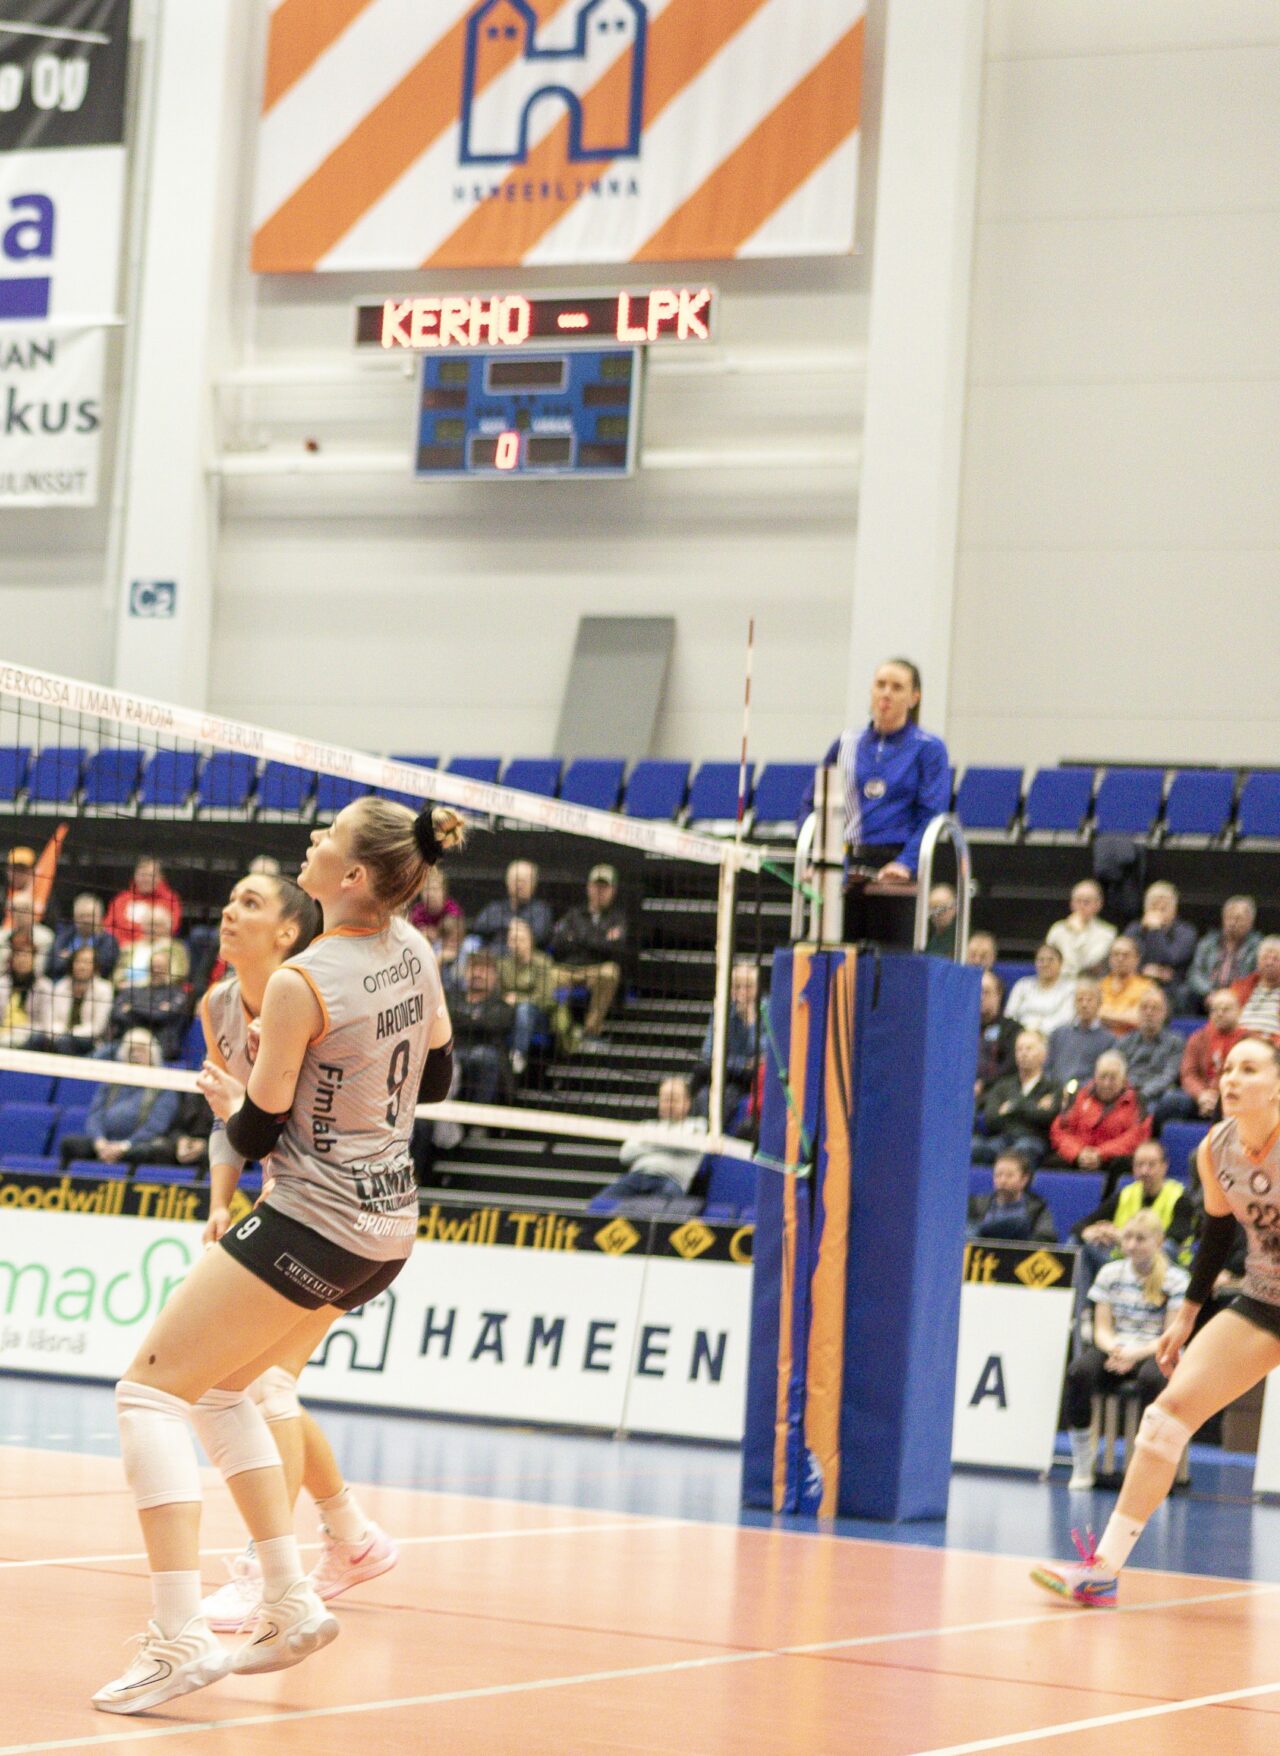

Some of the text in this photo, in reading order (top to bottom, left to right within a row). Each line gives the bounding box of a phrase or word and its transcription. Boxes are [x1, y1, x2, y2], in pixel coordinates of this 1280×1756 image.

[32, 55, 89, 111] Oy
[381, 295, 531, 347] KERHO
[616, 289, 710, 342] LPK
[495, 432, 518, 469] 0
[75, 687, 123, 719] ILMAN
[376, 994, 424, 1041] ARONEN
[384, 1038, 411, 1129] 9
[310, 1064, 343, 1154] Fimlab
[132, 1182, 202, 1221] Tilit
[236, 1216, 262, 1240] 9
[420, 1204, 583, 1253] dwill Tilit
[0, 1325, 22, 1353] ja
[27, 1327, 88, 1357] läsnä
